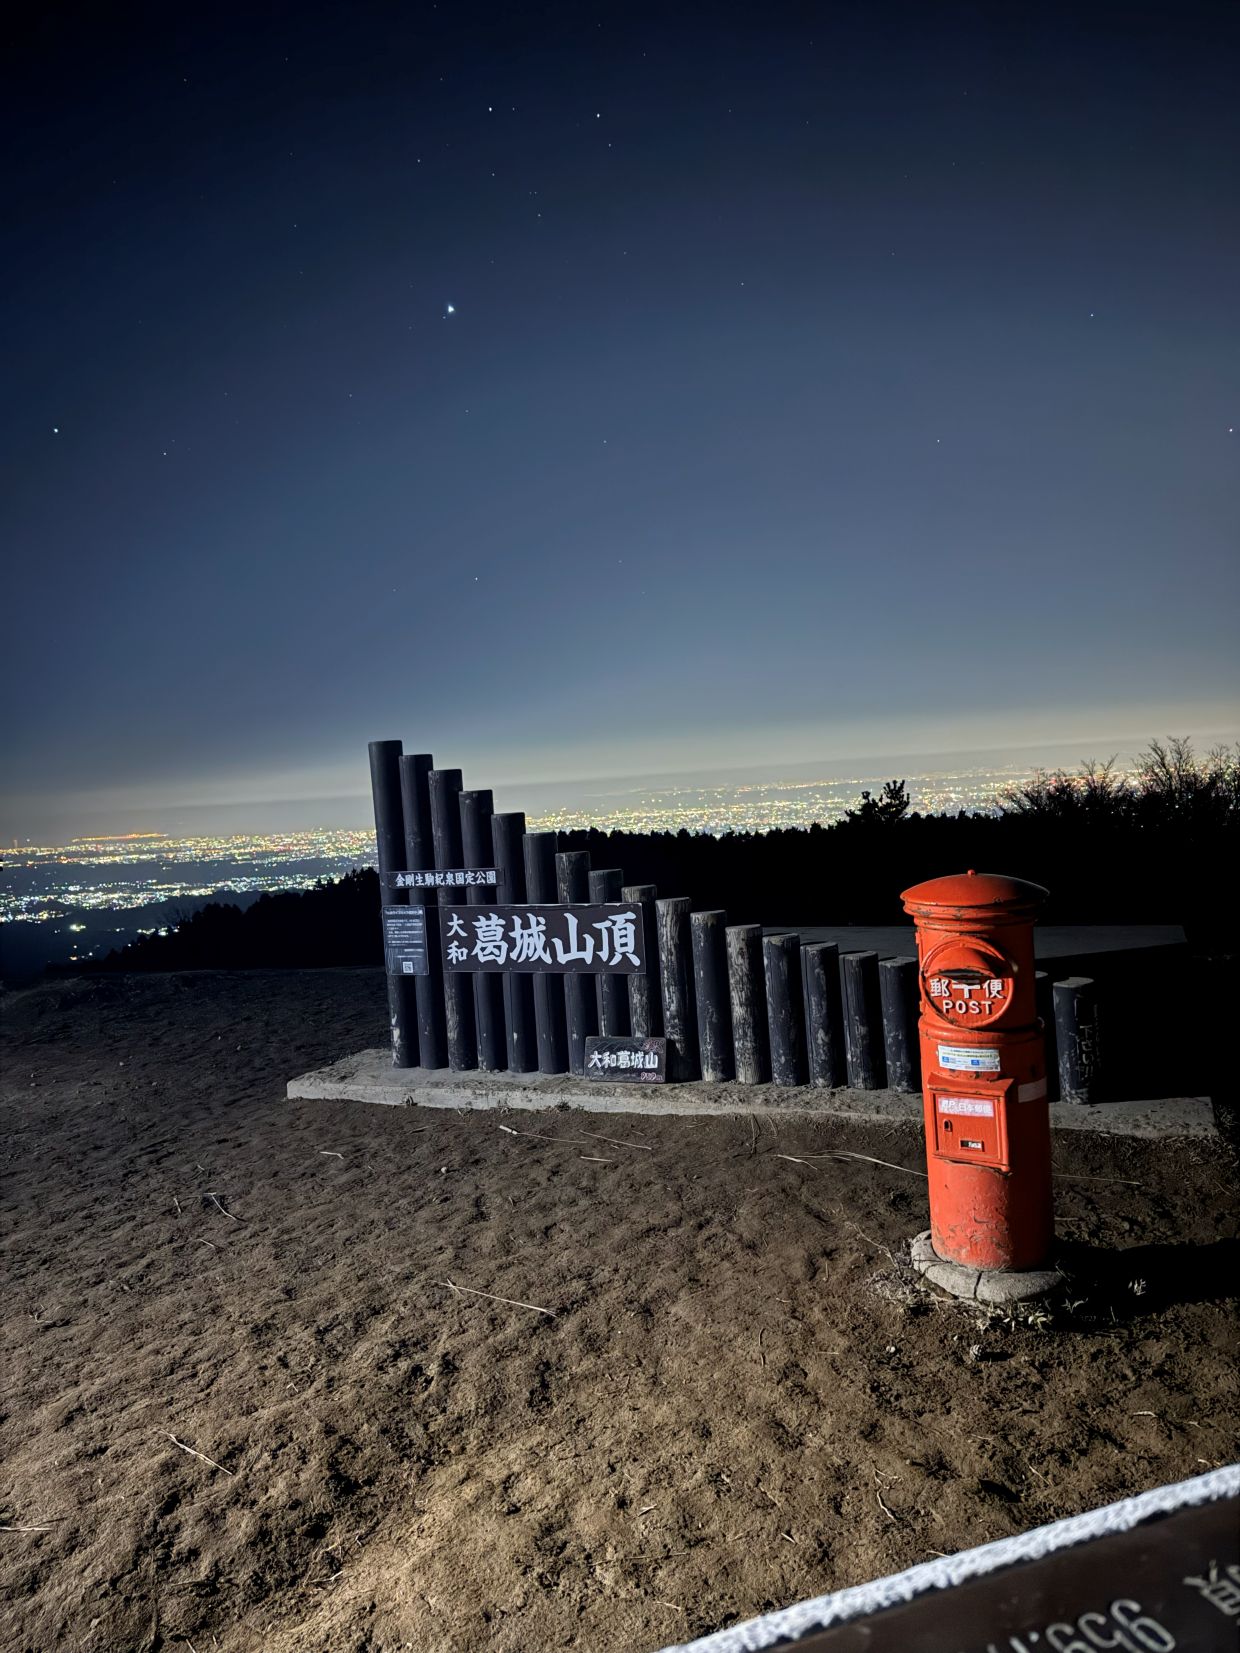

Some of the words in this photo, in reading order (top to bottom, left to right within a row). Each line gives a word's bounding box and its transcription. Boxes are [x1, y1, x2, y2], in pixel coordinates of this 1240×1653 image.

[395, 870, 497, 887] 金剛生駒紀泉国定公園
[446, 913, 468, 965] 大和
[471, 911, 641, 967] 葛城山頂
[942, 1000, 993, 1015] POST
[587, 1050, 659, 1069] 大和葛城山
